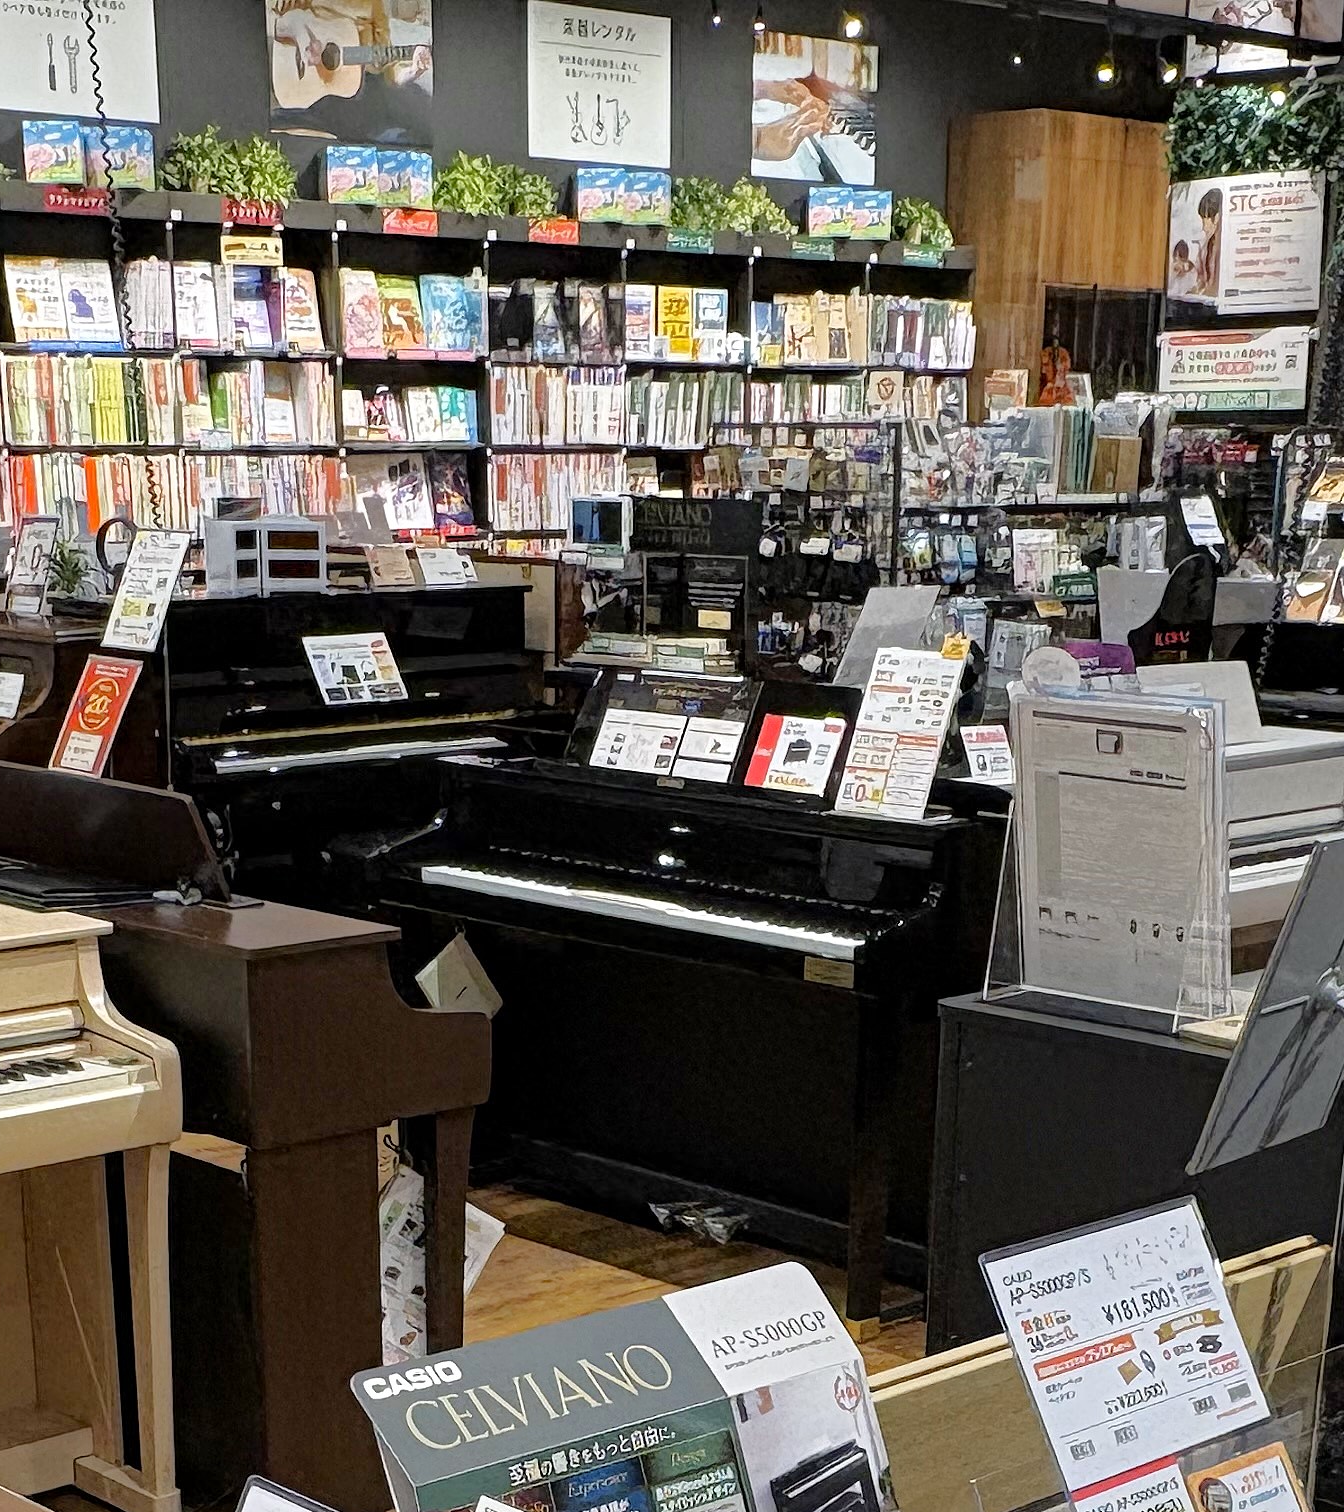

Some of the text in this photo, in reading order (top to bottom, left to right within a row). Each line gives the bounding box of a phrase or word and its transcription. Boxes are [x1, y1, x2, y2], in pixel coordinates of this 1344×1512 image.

[711, 1310, 827, 1359] AP-S5000GP
[363, 1360, 463, 1400] CASIO
[405, 1344, 674, 1450] CELVIANO
